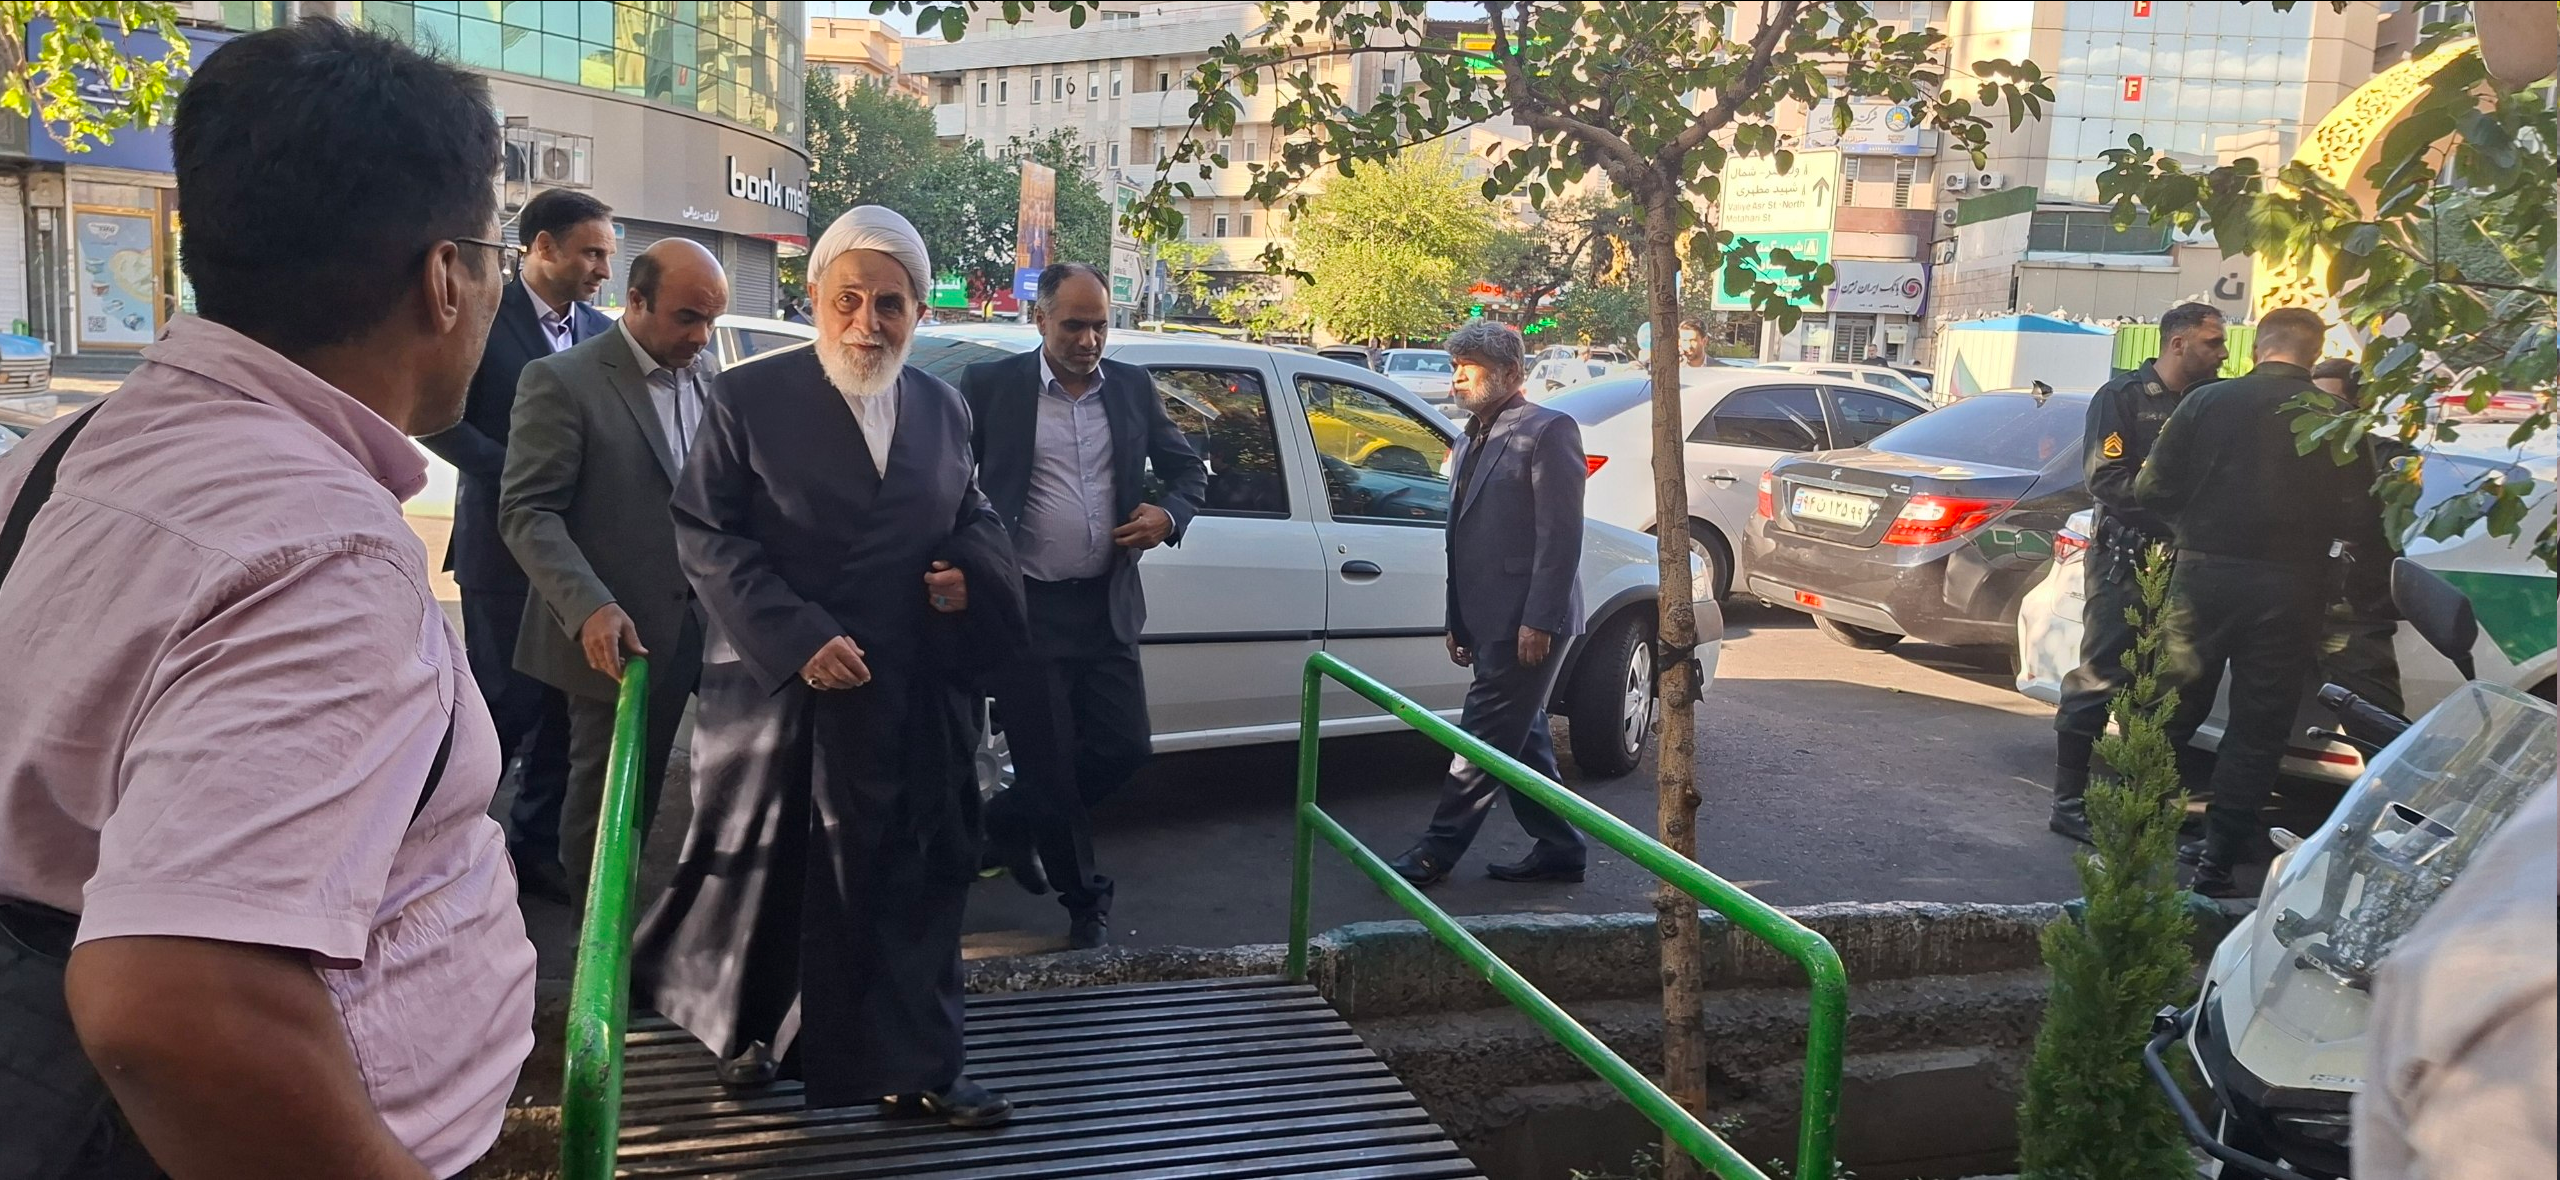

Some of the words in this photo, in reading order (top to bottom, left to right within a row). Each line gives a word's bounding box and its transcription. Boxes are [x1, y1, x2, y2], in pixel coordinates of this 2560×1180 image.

[2127, 81, 2139, 98] F
[1730, 166, 1757, 180] شمال
[730, 155, 782, 207] bank
[1736, 184, 1770, 198] مطهری
[1773, 182, 1798, 196] شهید
[1841, 280, 1858, 294] زمین
[1857, 283, 1880, 294] ایران
[1880, 275, 1904, 296] بانک
